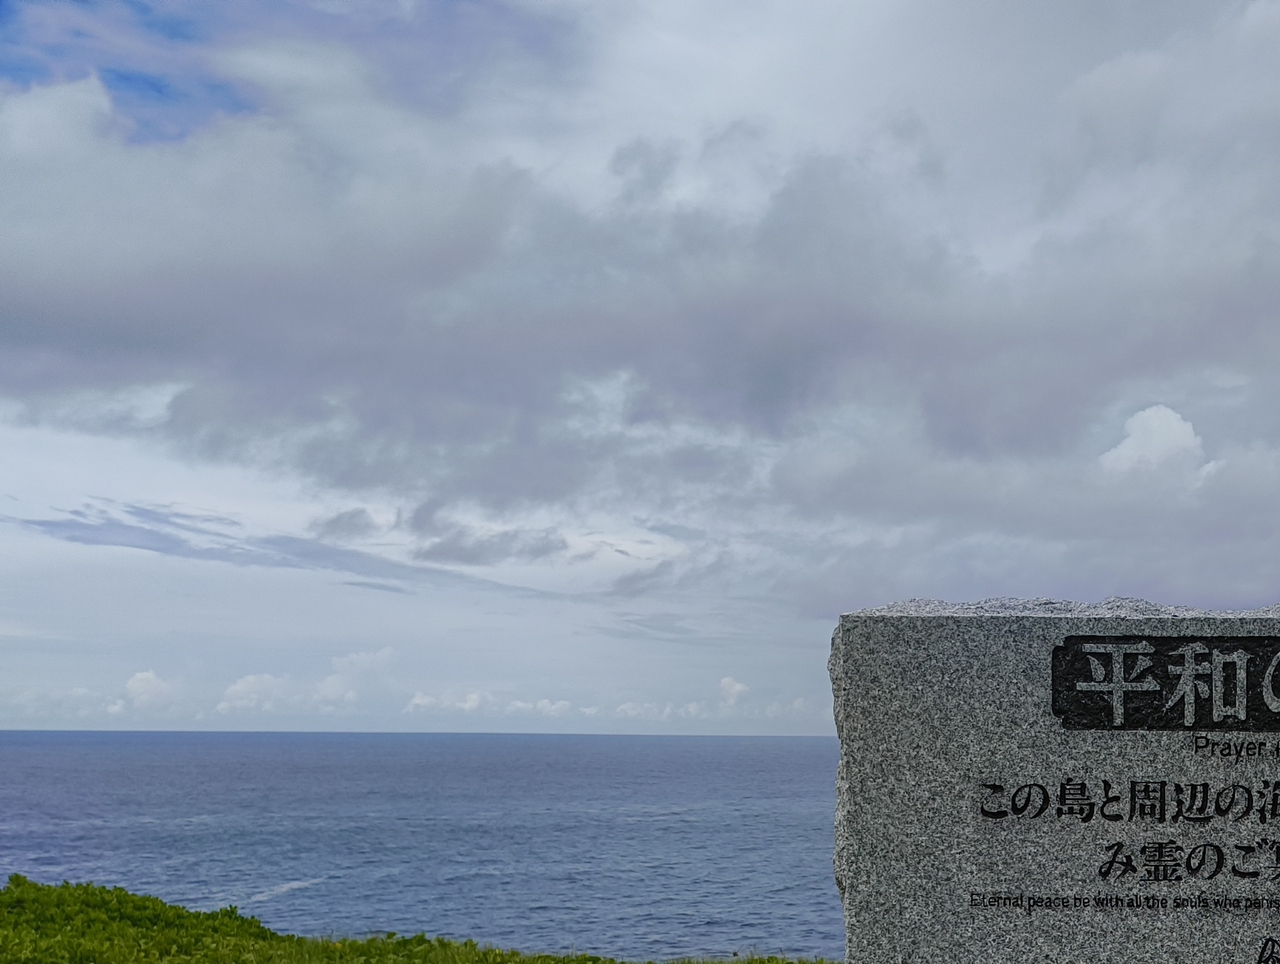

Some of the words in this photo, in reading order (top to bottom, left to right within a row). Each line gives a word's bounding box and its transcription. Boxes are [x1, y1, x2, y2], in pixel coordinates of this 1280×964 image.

[1194, 735, 1267, 765] Prayer
[970, 893, 1024, 908] Eternal
[1028, 897, 1069, 915] peace
[1074, 894, 1090, 908] be
[1095, 893, 1124, 909] with
[1127, 893, 1143, 909] all
[1145, 894, 1168, 909] the
[1173, 895, 1209, 909] souls
